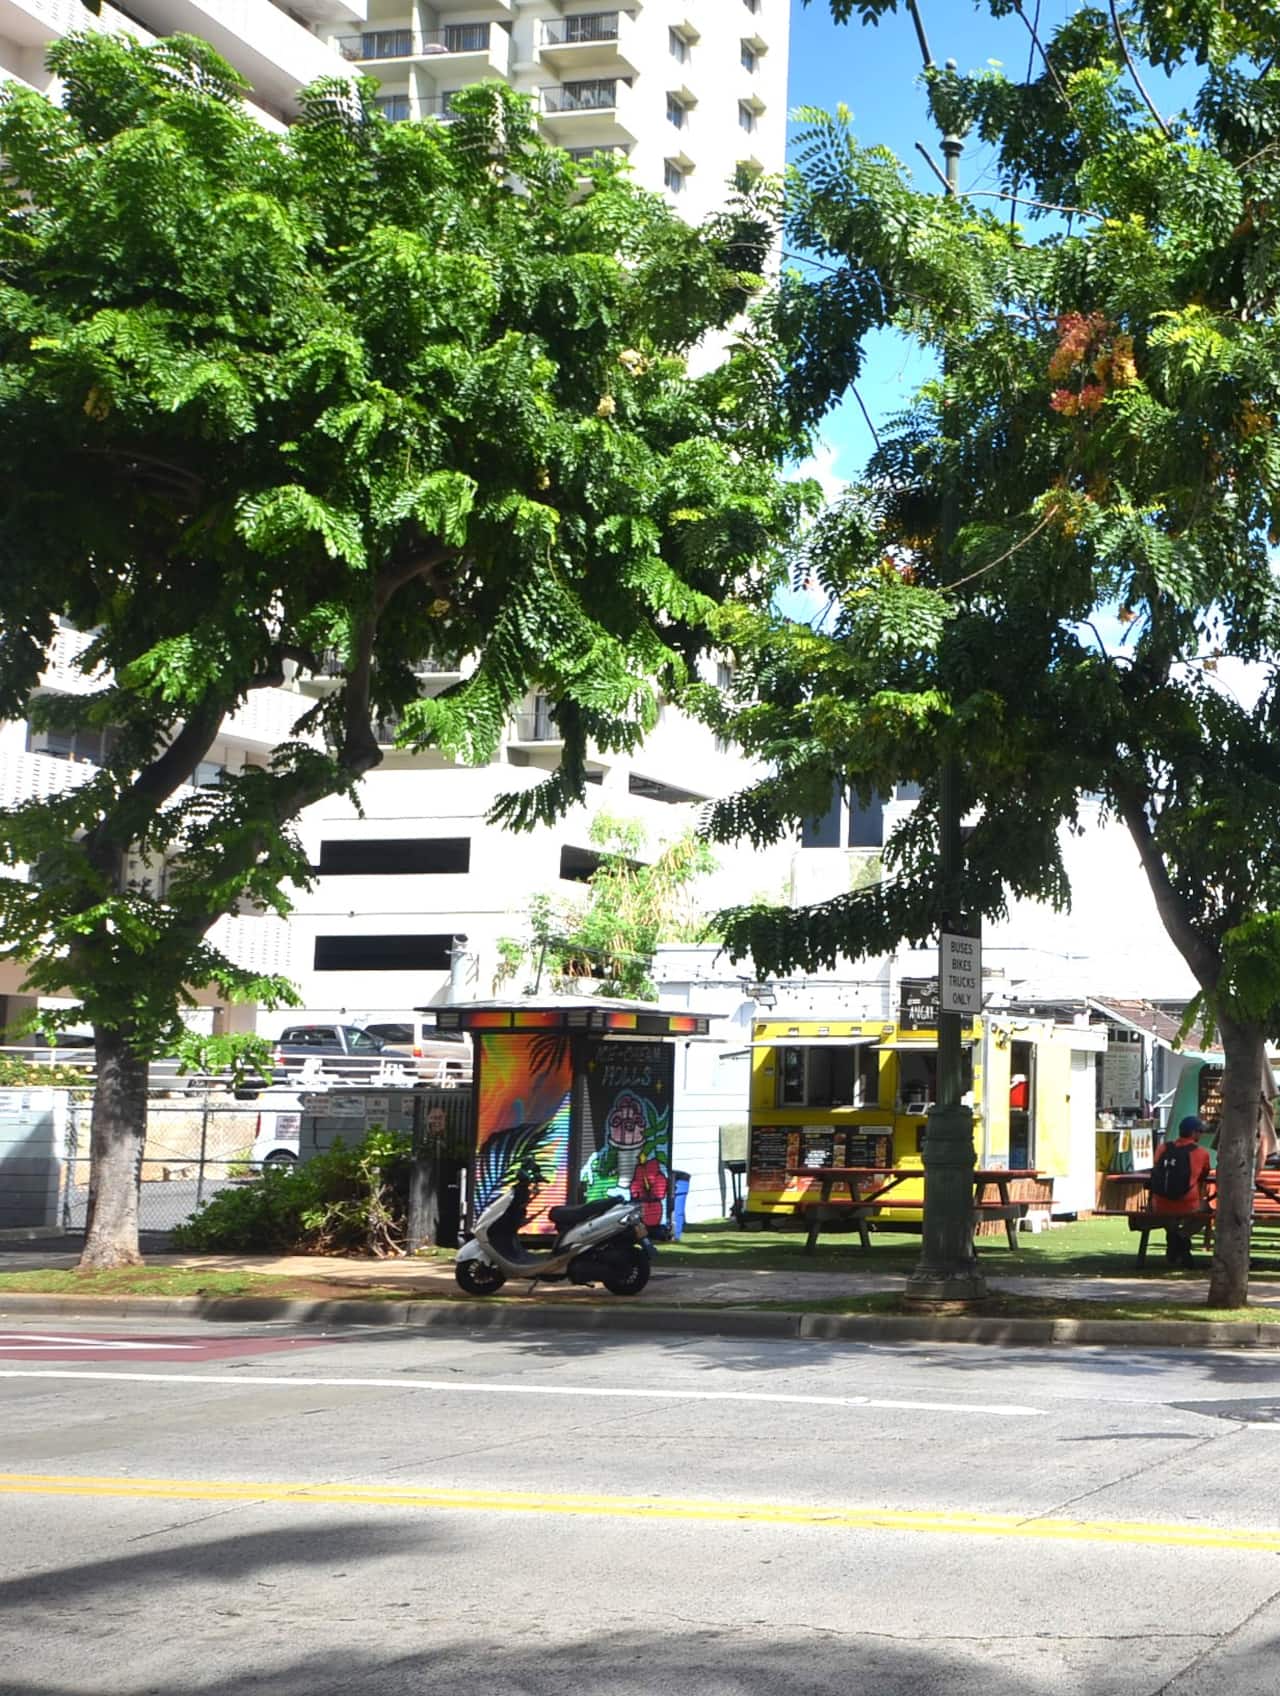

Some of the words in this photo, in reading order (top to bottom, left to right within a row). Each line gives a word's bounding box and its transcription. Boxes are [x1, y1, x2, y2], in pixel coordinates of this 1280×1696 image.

[950, 941, 973, 955] BUSES
[951, 958, 972, 972] BIKES
[949, 975, 976, 989] TRUCKS
[952, 992, 972, 1006] ONLY
